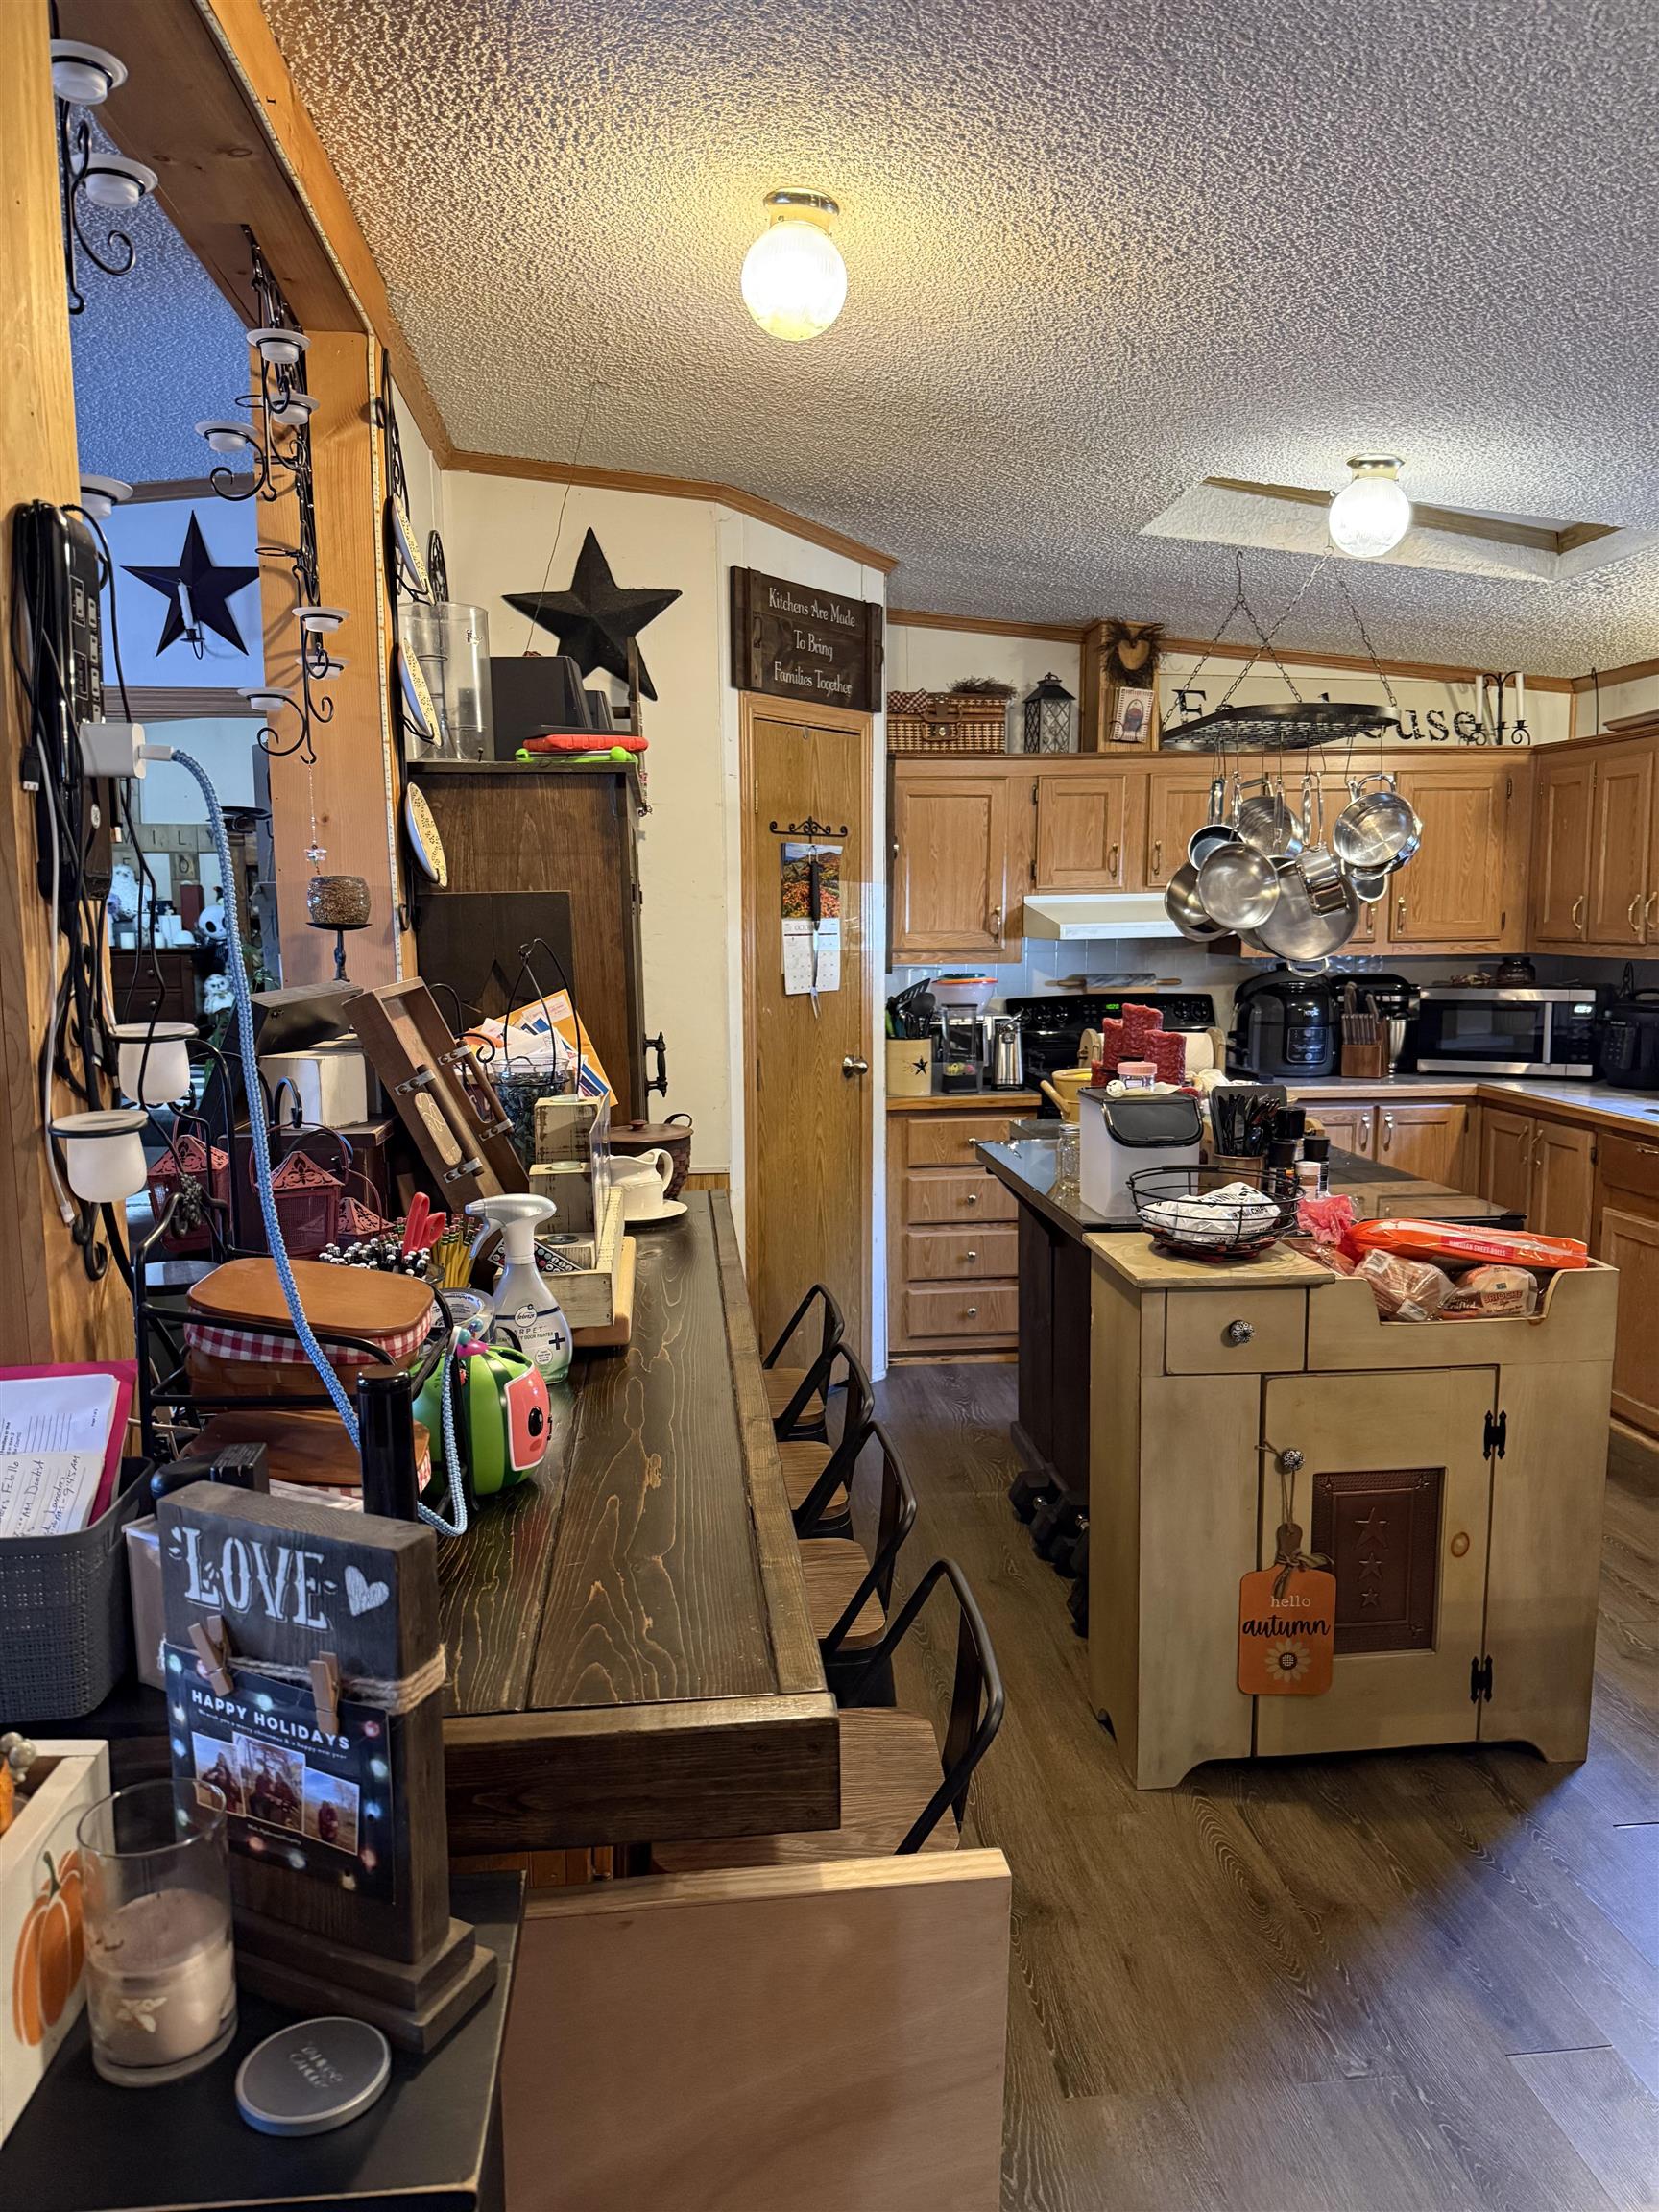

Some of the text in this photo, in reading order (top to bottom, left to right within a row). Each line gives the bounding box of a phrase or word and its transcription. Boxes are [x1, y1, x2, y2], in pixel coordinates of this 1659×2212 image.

[769, 587, 856, 627] Kitchens Are Made
[793, 629, 833, 662] To Bring
[774, 661, 853, 697] Families Together
[1484, 1290, 1523, 1303] BRIOCHE
[514, 1327, 542, 1336] ARPET
[182, 1527, 333, 1631] LOVE
[1270, 1595, 1311, 1608] hello
[1242, 1614, 1331, 1638] autumn
[191, 1689, 350, 1750] HAPPY HOLIDAYS
